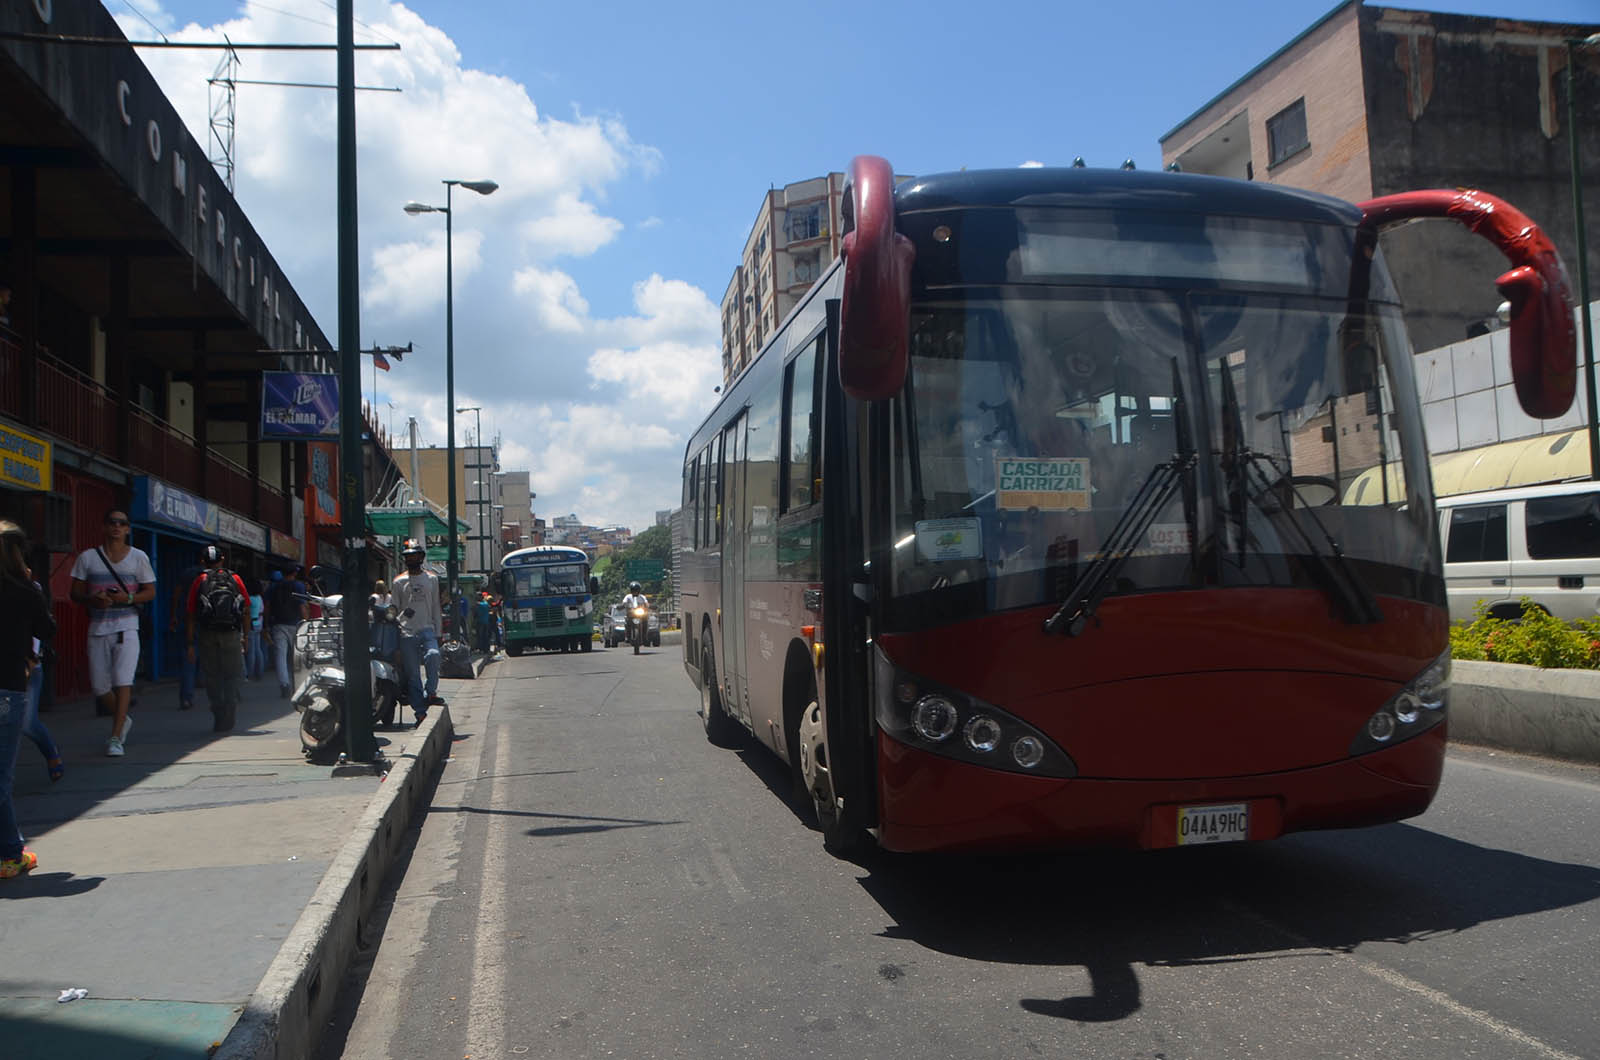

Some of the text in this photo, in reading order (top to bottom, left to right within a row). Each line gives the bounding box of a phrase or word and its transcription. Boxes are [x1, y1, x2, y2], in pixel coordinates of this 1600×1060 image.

[117, 79, 280, 321] COMERCIAL
[265, 411, 317, 425] EL PALMAR
[1002, 462, 1081, 477] CASCADA
[999, 476, 1086, 491] CARRIZAL
[1151, 529, 1173, 544] LOS
